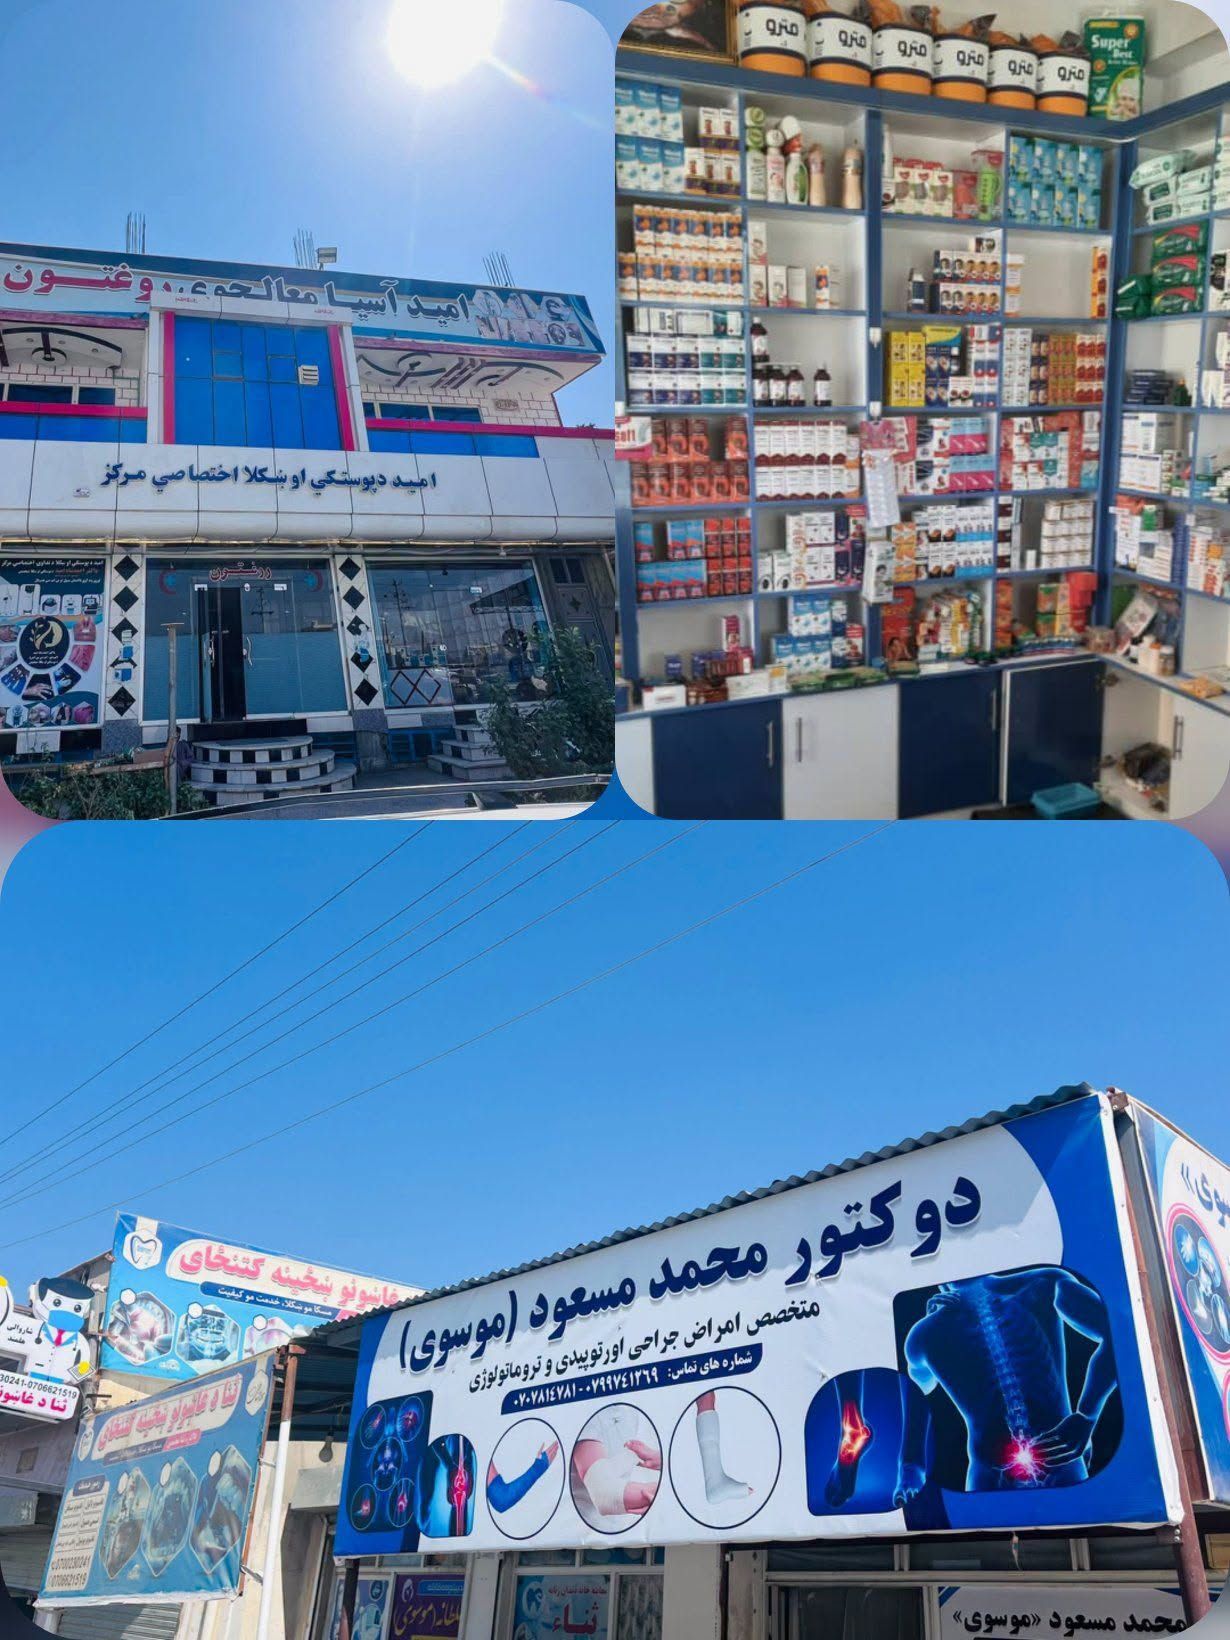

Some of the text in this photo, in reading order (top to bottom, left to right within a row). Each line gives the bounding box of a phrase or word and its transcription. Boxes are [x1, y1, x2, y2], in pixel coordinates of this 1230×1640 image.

[1091, 34, 1130, 51] Super
[100, 463, 146, 488] مرکز
[209, 561, 272, 582] روغتون
[649, 1240, 769, 1297] محمد
[528, 1273, 637, 1328] مسعود
[746, 1298, 821, 1335] متخصص
[684, 1312, 740, 1348] امراض
[628, 1328, 680, 1361] جراحی
[544, 1361, 553, 1378] و
[699, 1355, 720, 1376] های
[725, 1350, 753, 1375] شماره
[1049, 1610, 1117, 1637] مسعود
